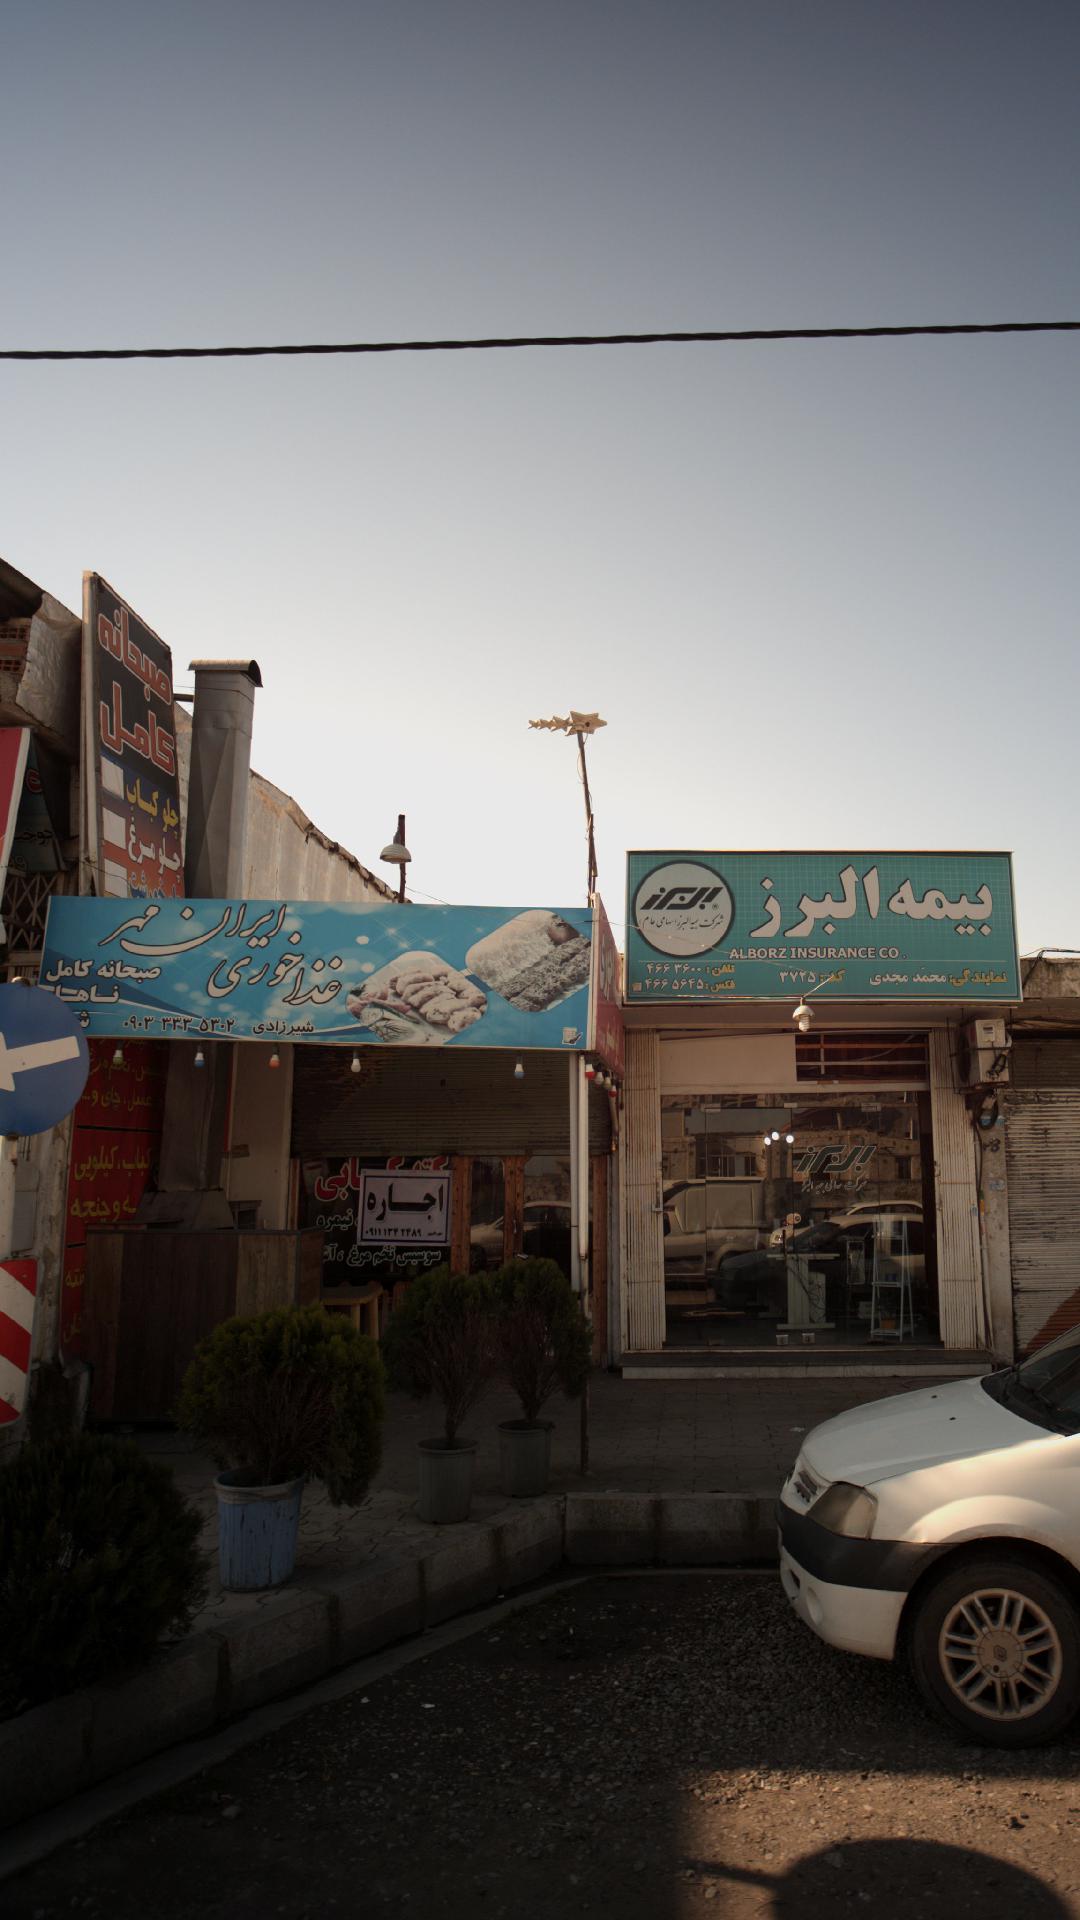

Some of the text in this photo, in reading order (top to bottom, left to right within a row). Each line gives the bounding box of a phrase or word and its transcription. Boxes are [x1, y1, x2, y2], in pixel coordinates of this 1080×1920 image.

[98, 606, 172, 706] صبحانه
[100, 680, 175, 776] کامل
[749, 864, 993, 939] بیمه البرز
[98, 903, 287, 956] ایران مهر
[46, 959, 161, 983] صبحانه کامل
[729, 947, 787, 960] ALBORZ
[789, 946, 876, 960] INSURANCE
[54, 984, 120, 1003] ناها
[252, 1019, 315, 1035] شیرزادی
[367, 1183, 444, 1221] اجاره
